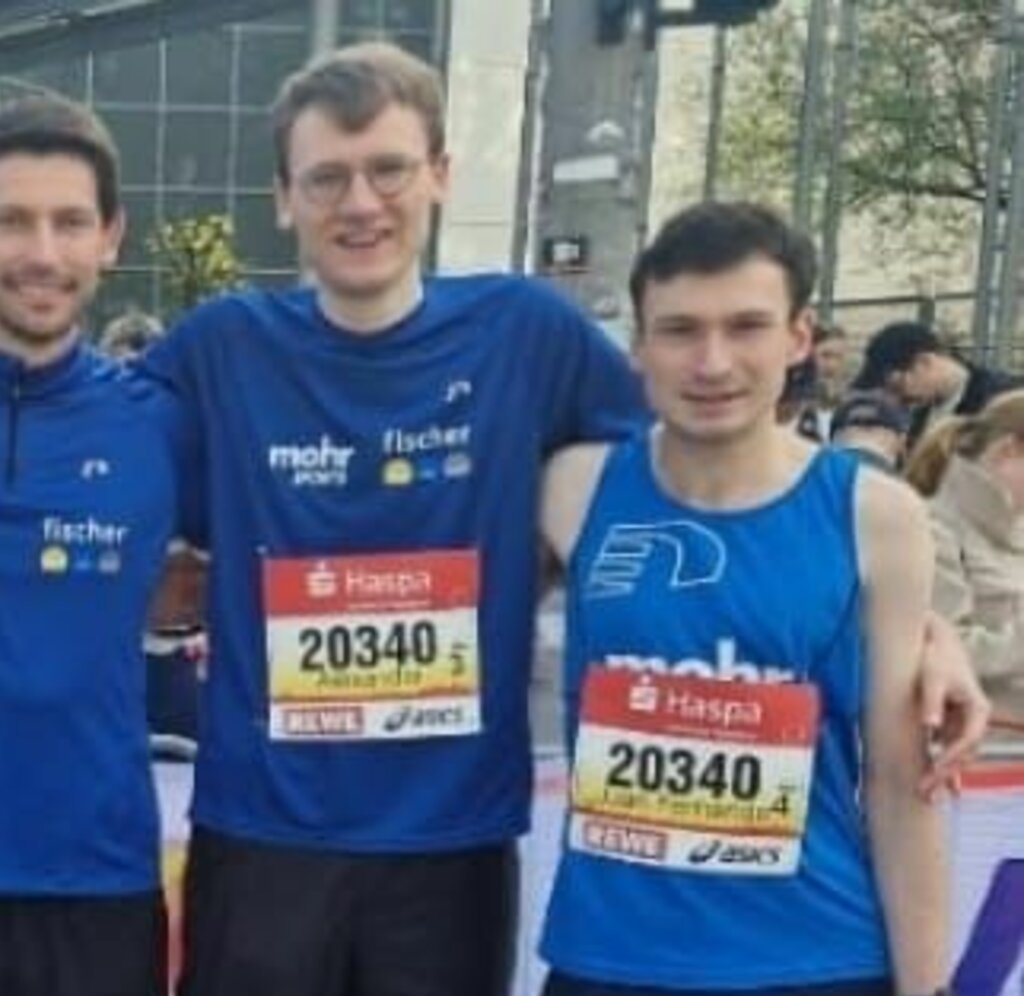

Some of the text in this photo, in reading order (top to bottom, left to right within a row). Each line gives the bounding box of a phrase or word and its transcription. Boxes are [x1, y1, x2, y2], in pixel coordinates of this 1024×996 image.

[269, 433, 355, 469] mohr
[382, 424, 471, 454] fischer
[43, 516, 129, 545] fischer
[345, 568, 431, 597] Haspa
[298, 619, 437, 673] 20340
[286, 708, 359, 734] REWE
[666, 688, 763, 726] Haspa
[606, 742, 762, 801] 20340
[585, 822, 665, 860] REWE
